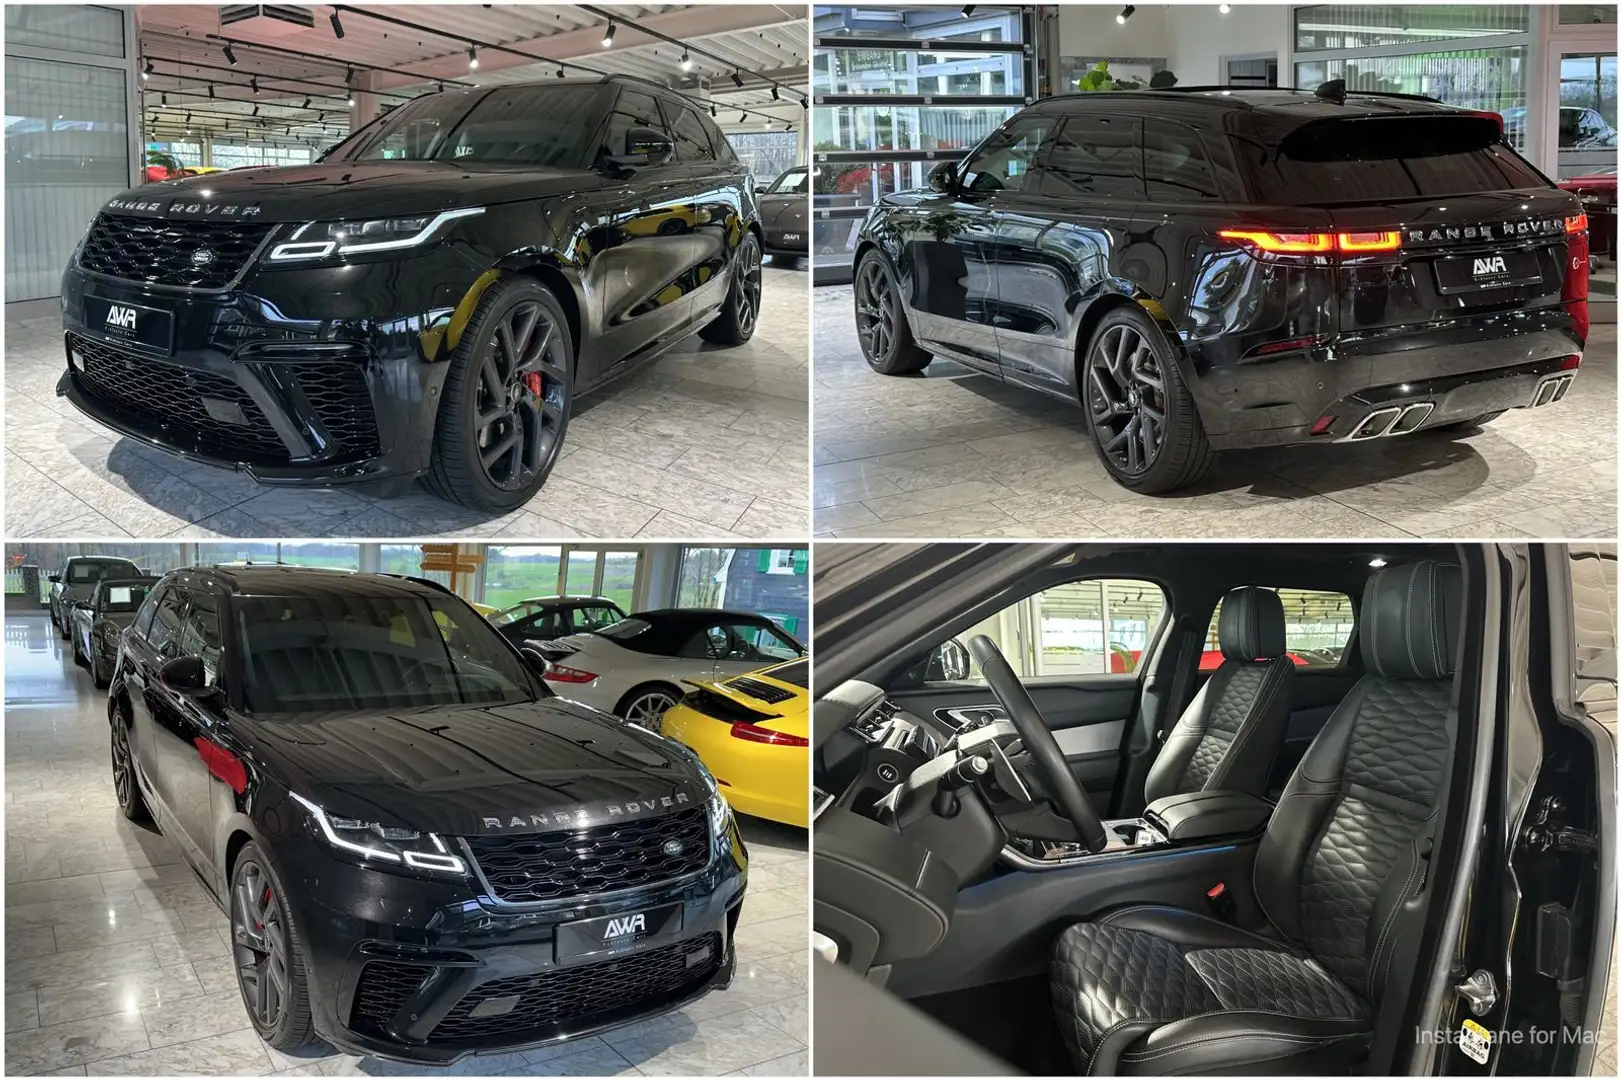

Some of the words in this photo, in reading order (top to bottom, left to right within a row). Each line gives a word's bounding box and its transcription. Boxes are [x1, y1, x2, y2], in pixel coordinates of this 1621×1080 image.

[169, 203, 261, 216] ROVER
[1409, 225, 1493, 242] RANGE
[1503, 218, 1564, 236] ROVER
[606, 792, 689, 816] ROVER
[1462, 1041, 1485, 1059] AIRBAG
